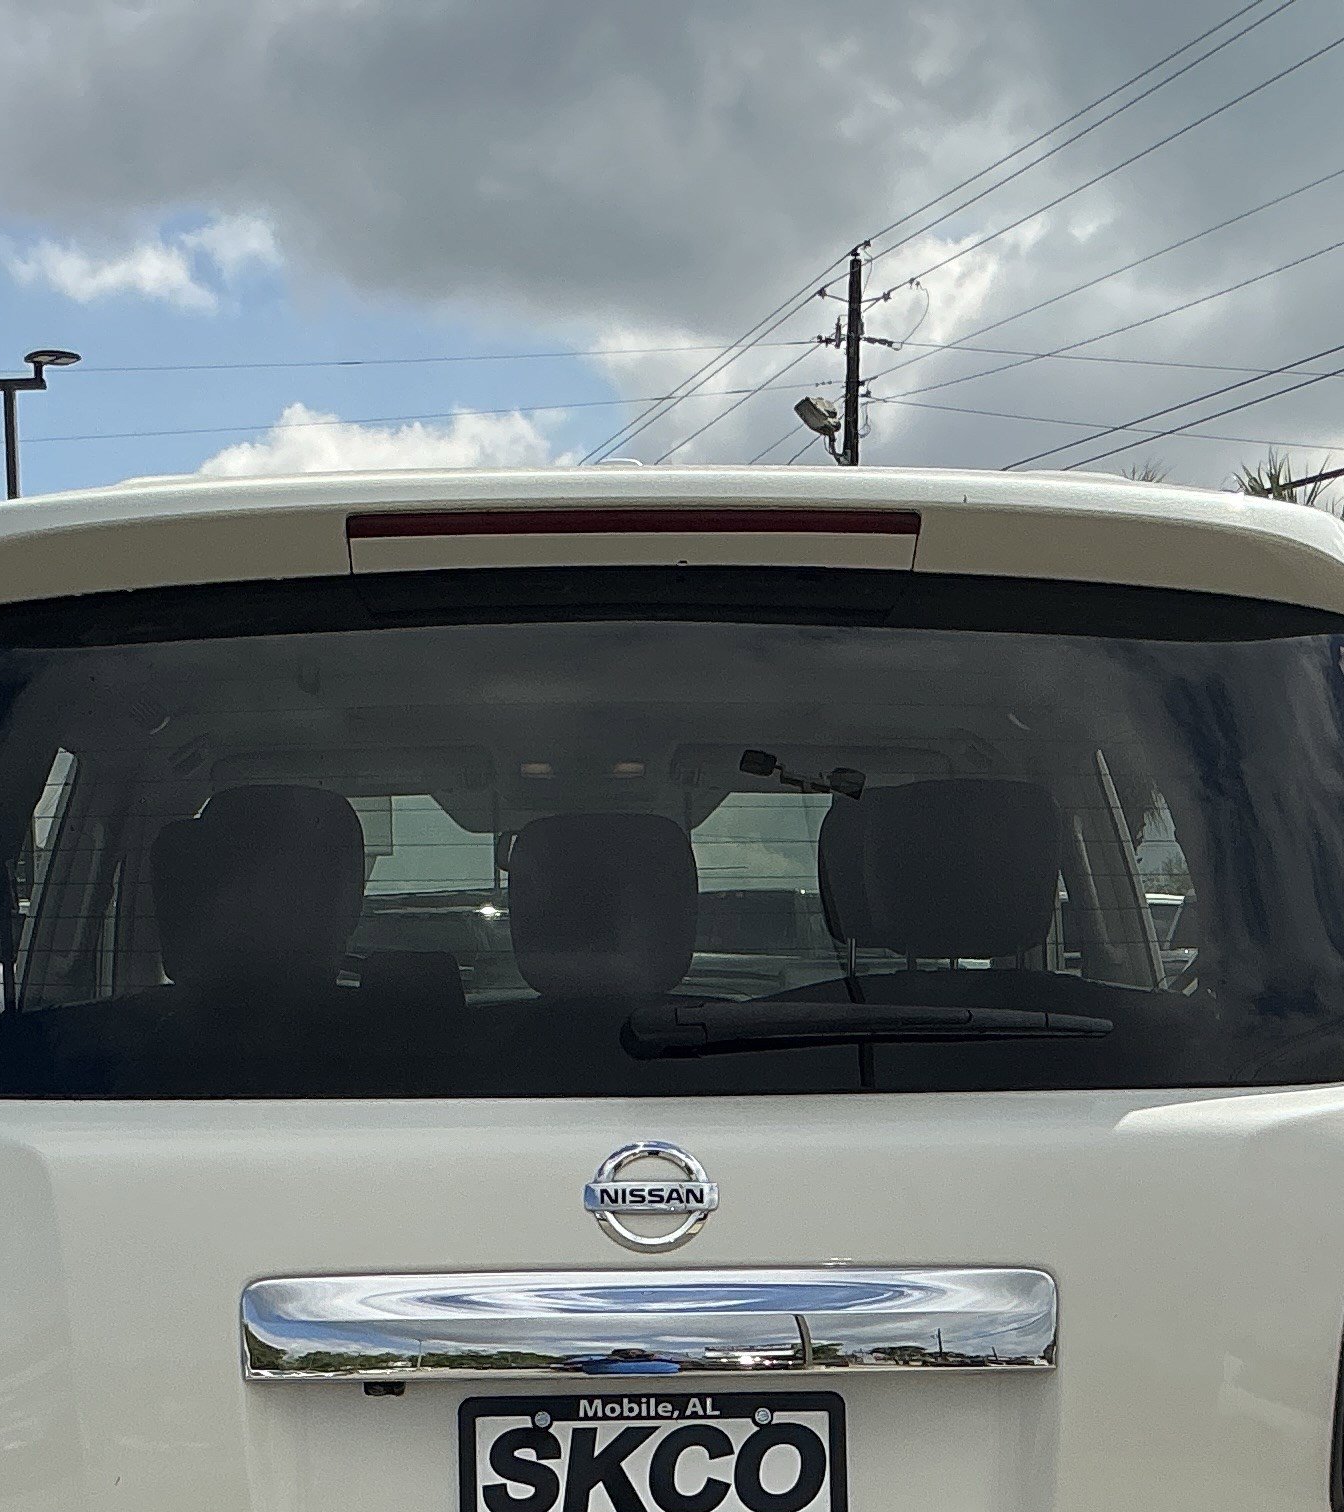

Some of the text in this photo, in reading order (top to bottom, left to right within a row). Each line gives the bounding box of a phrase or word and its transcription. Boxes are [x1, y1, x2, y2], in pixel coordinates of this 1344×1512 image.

[599, 1187, 705, 1205] NISSAN
[578, 1397, 721, 1419] Mobile, AL
